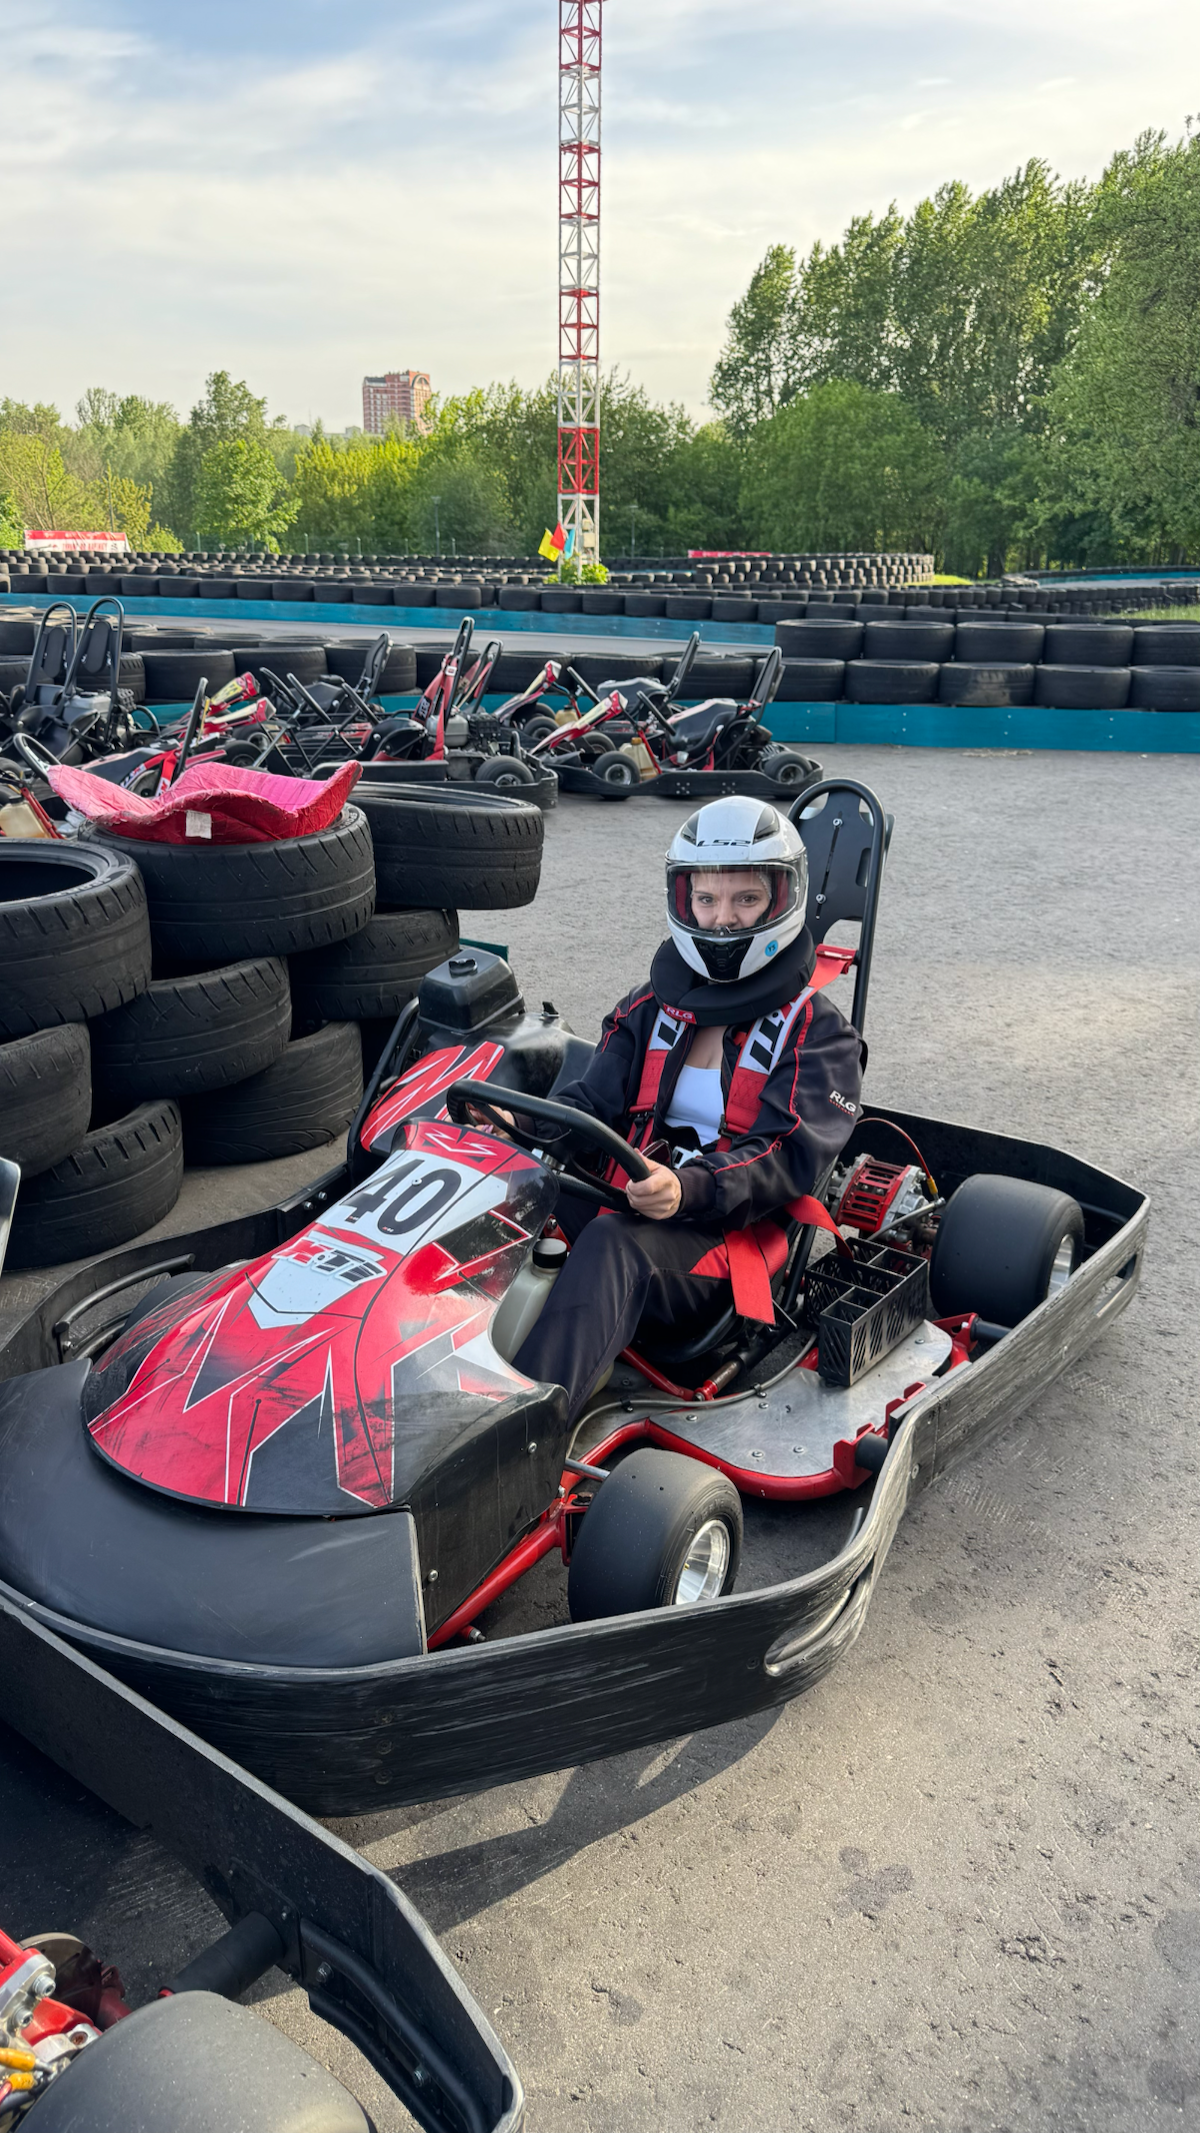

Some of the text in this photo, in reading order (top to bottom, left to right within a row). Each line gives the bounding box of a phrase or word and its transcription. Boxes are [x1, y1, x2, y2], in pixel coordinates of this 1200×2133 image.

[697, 839, 752, 848] LS2
[666, 1006, 693, 1020] RLG
[829, 1090, 857, 1113] RLG
[338, 1158, 462, 1235] 40
